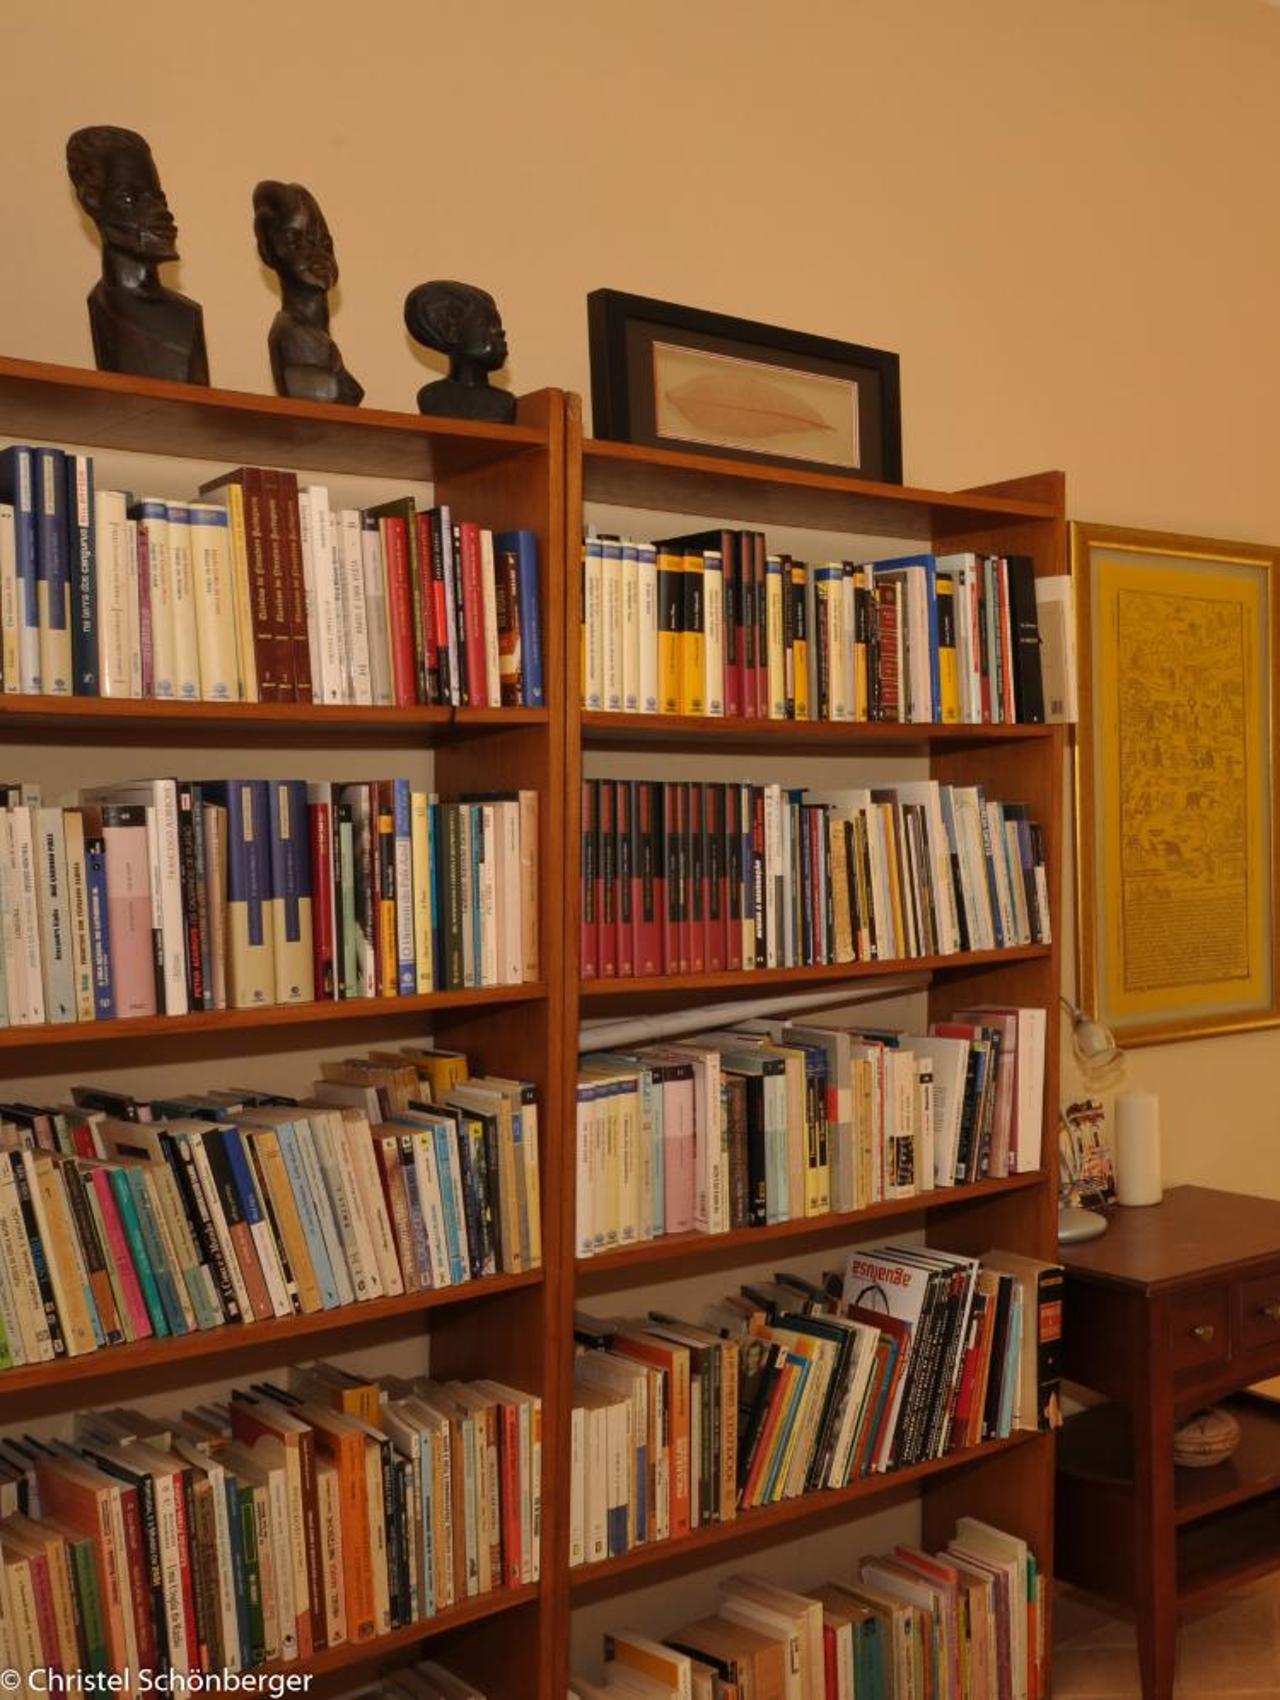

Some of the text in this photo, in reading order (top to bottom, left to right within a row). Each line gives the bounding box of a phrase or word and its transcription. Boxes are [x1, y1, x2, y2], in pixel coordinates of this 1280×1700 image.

[79, 529, 91, 575] cangurus
[80, 575, 90, 593] dos
[81, 594, 90, 619] terra
[852, 1260, 912, 1287] agualusa
